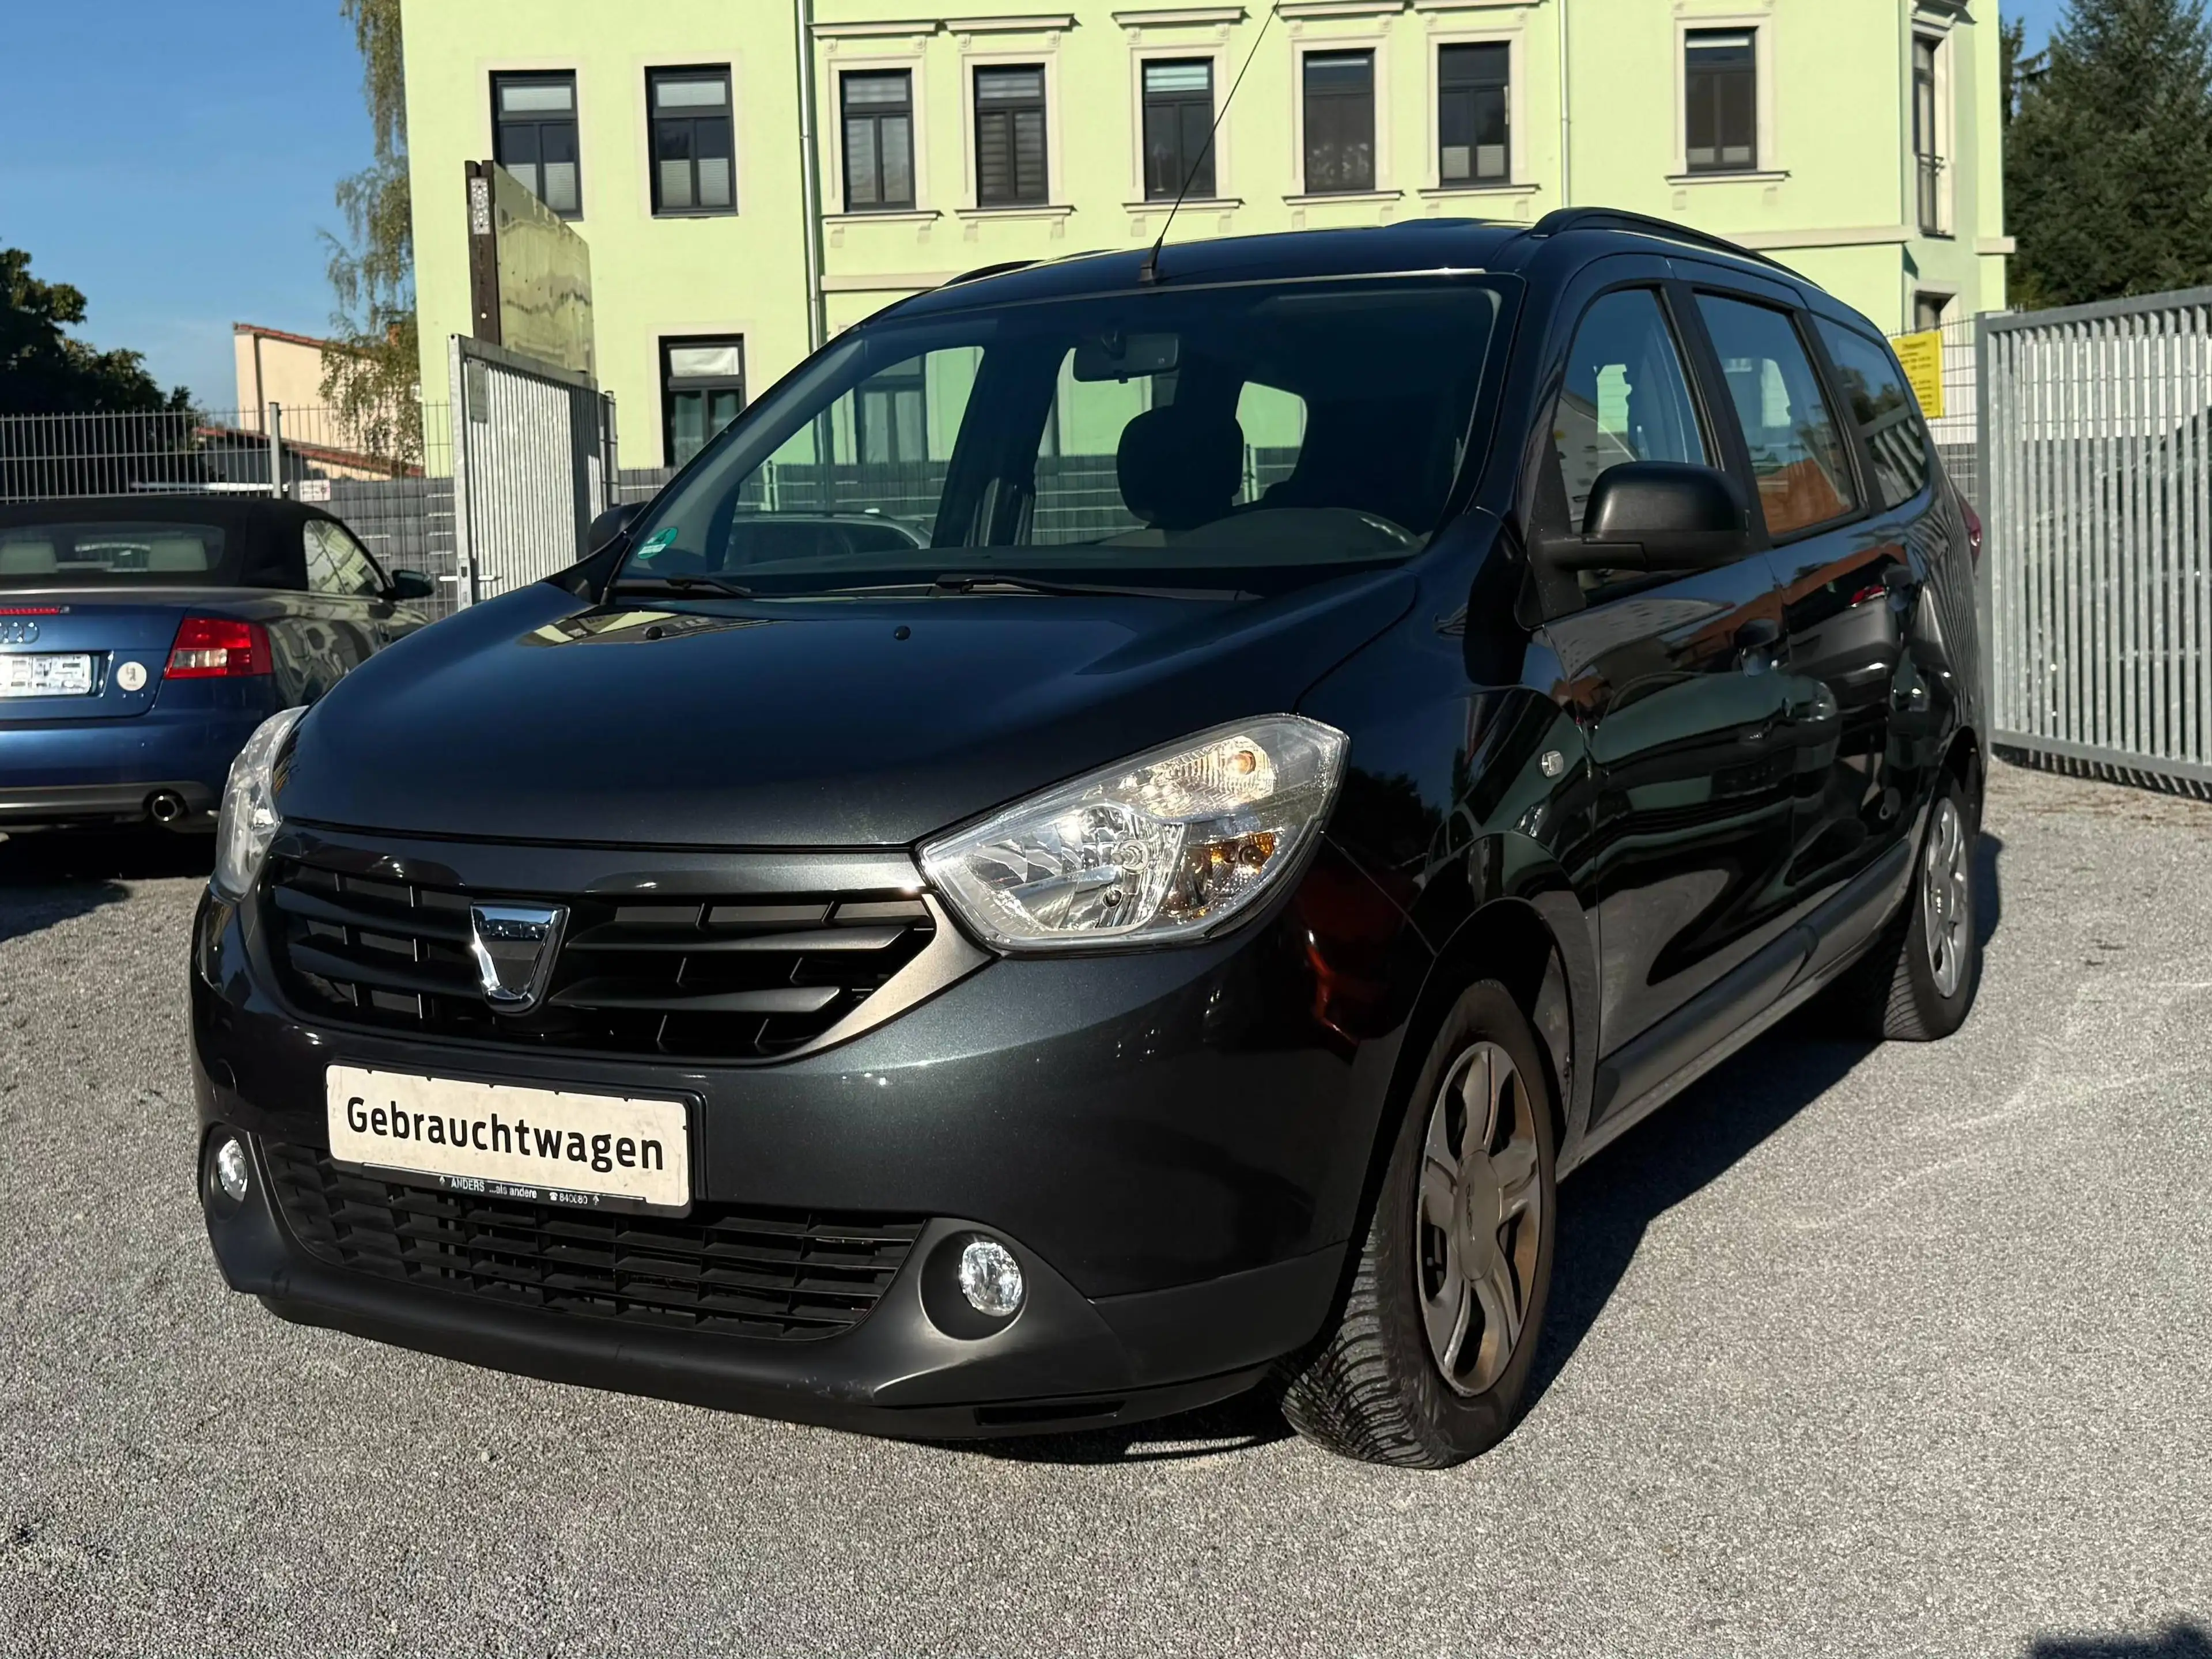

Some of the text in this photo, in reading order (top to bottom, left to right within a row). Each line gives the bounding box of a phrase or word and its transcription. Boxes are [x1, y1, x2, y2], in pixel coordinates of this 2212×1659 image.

[347, 1097, 663, 1173] Gebrauchtwagen
[451, 1177, 485, 1192] ANDERS
[509, 1187, 537, 1199] andere
